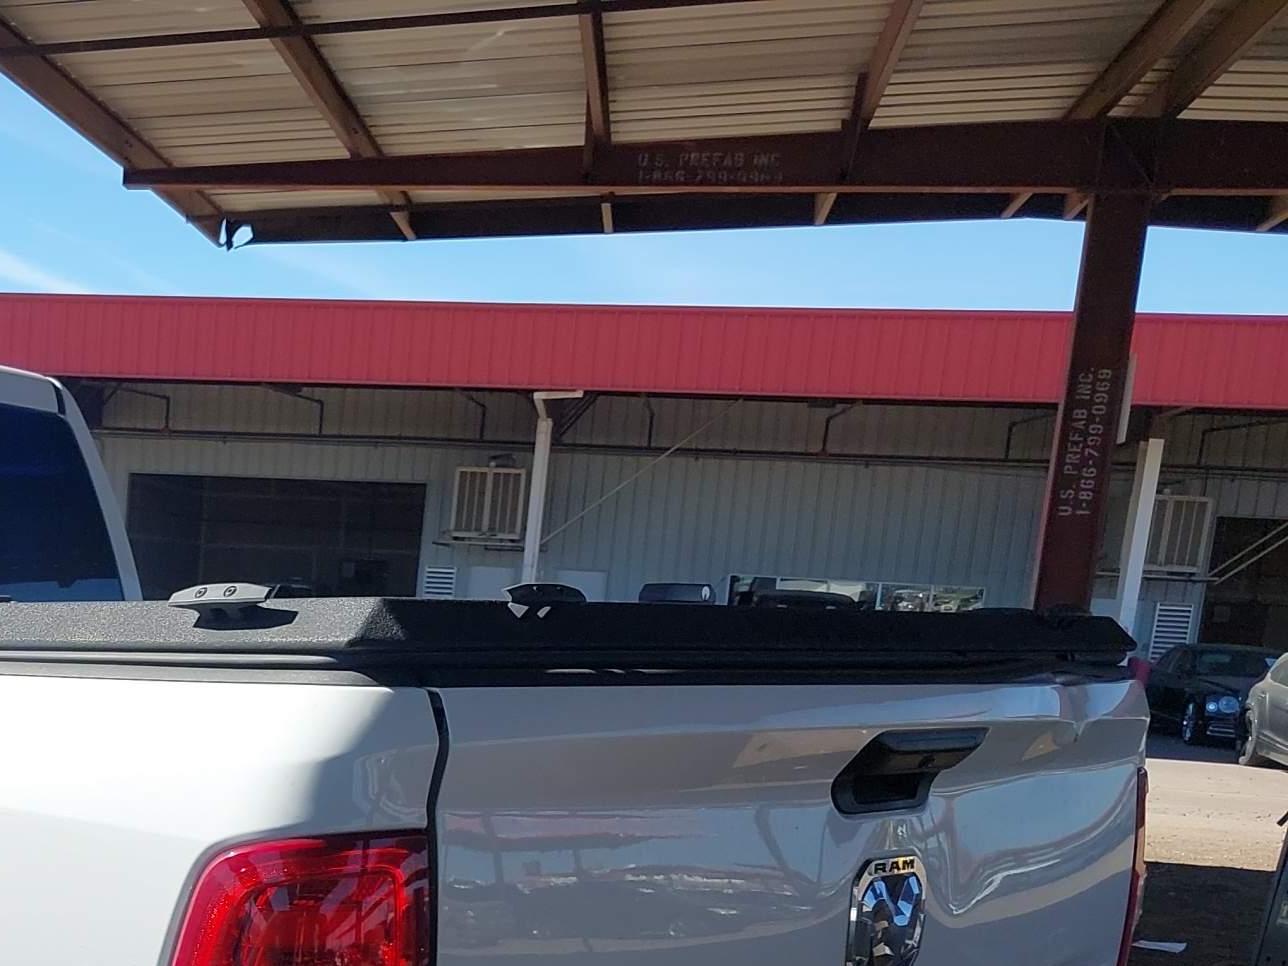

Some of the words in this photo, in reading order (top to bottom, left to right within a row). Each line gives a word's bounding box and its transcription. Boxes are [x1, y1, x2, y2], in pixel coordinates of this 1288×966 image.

[638, 153, 670, 167] U.S.
[679, 152, 745, 167] PREFAB
[1075, 367, 1095, 400] INC.
[1064, 409, 1088, 475] PREFAB
[1076, 368, 1113, 515] 1-866-799-0969
[1058, 484, 1077, 516] U.S.
[873, 858, 916, 875] RAM
